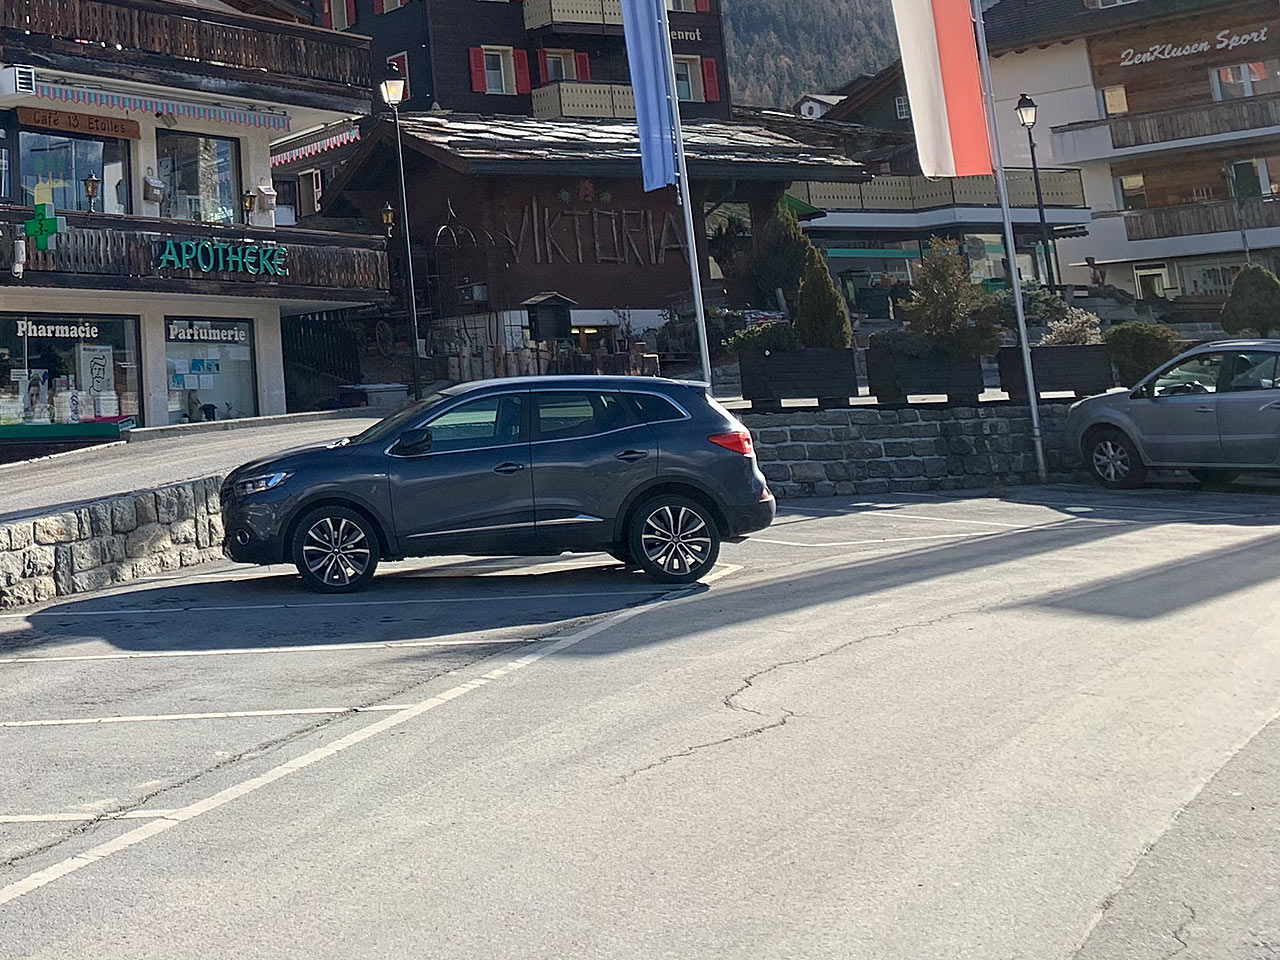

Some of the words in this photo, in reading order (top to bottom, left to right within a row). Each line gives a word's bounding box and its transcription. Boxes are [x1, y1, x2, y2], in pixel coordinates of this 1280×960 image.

[1216, 27, 1268, 50] Sport
[68, 115, 79, 128] 13
[87, 118, 126, 134] Etoiles
[504, 195, 690, 265] VIKTORIA
[159, 240, 288, 276] APOTHEKE
[16, 320, 99, 338] Pharmacie
[168, 324, 246, 341] Parfumerie
